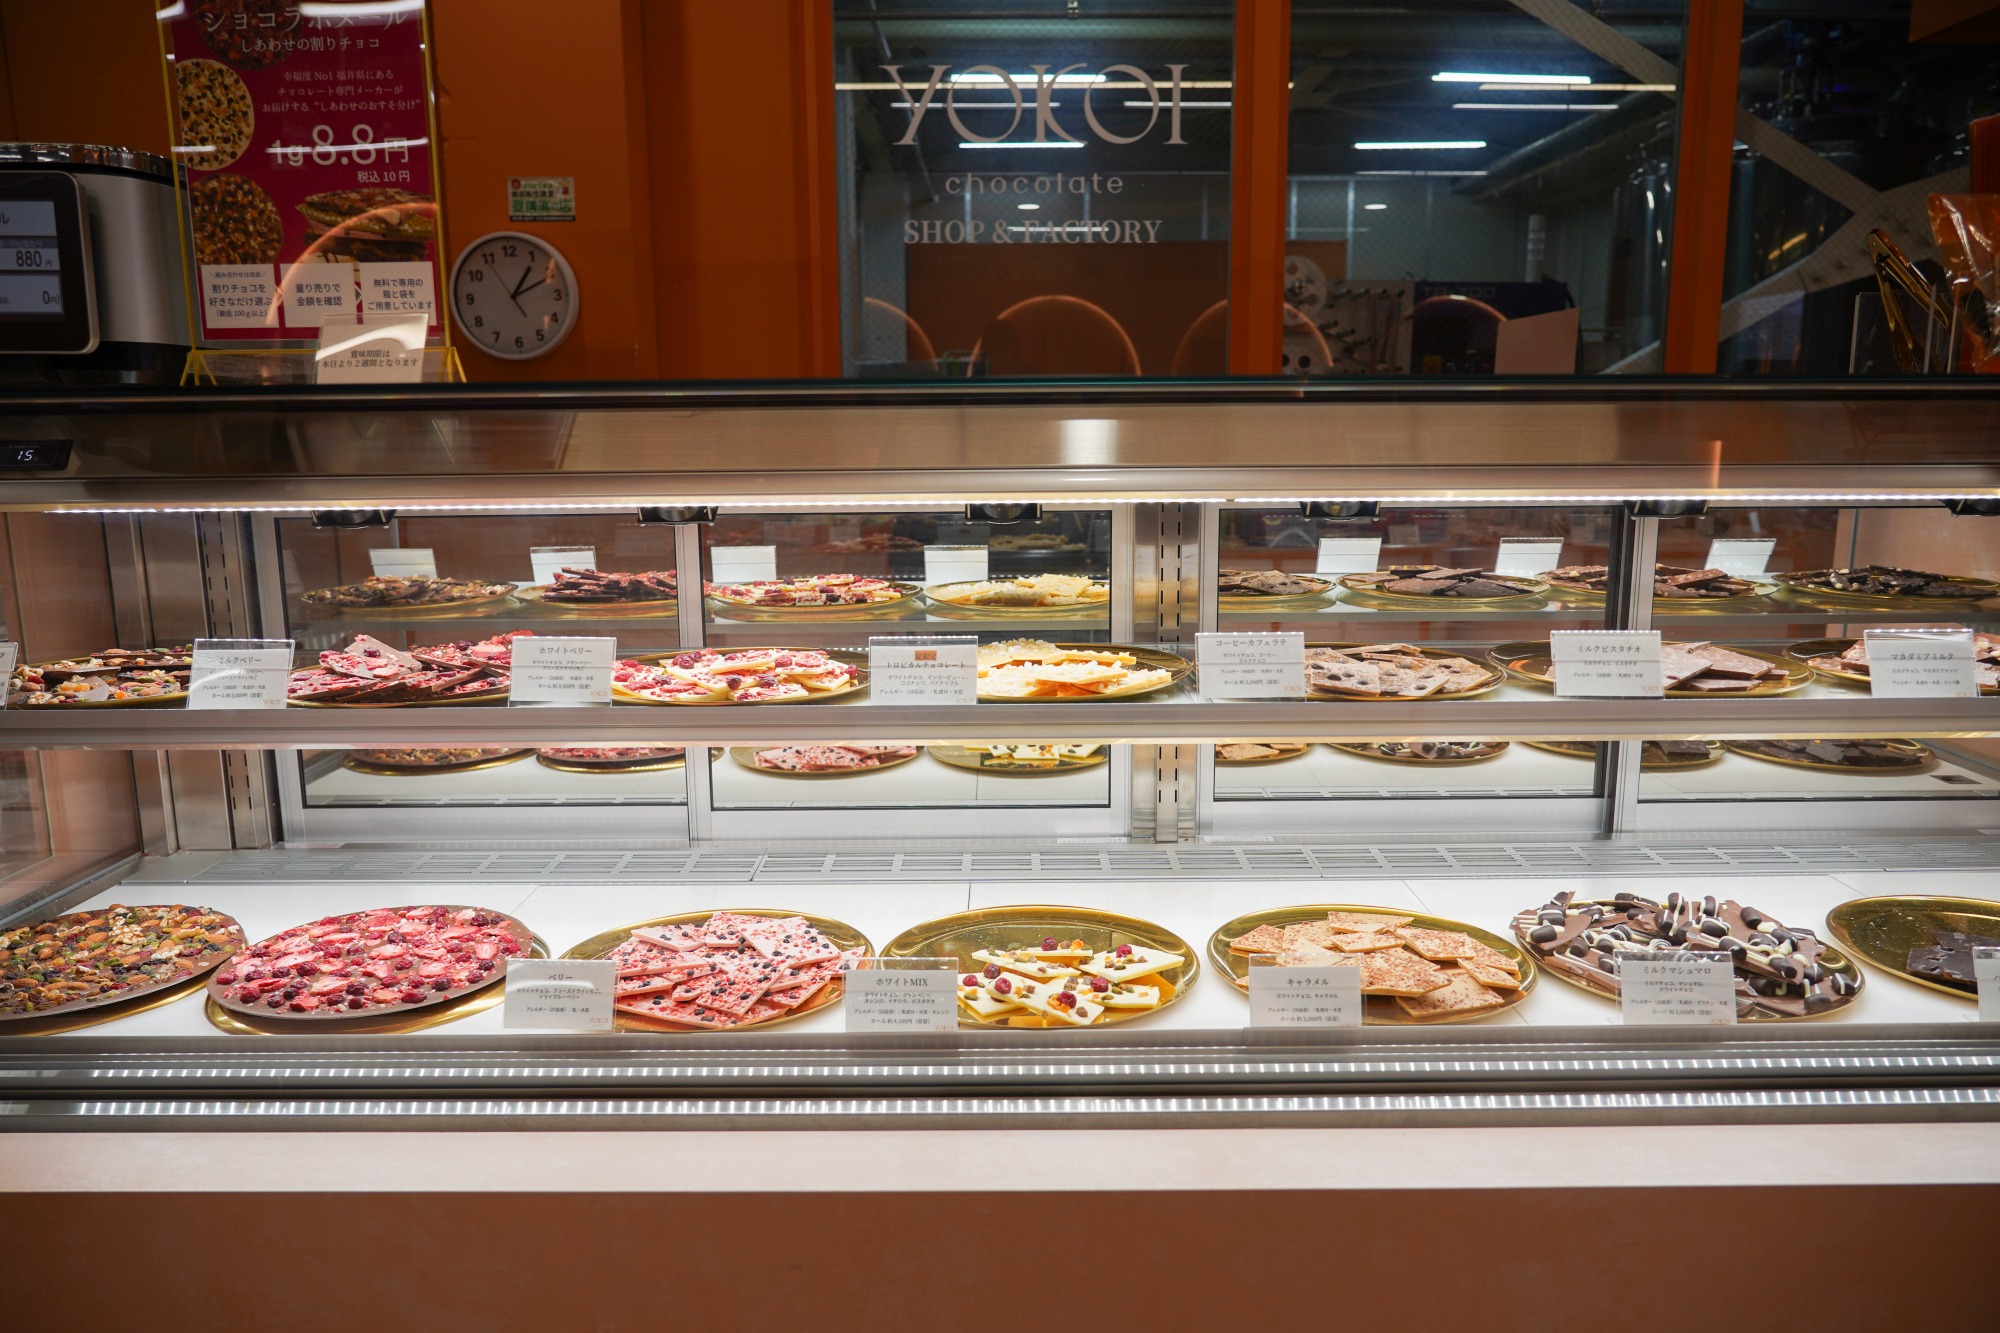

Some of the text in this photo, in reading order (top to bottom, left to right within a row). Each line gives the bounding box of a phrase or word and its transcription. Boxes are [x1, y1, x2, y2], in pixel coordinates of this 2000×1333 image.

[241, 36, 380, 53] しあわせの割りチョコ
[337, 69, 394, 80] 福井県にある
[277, 84, 403, 97] チョコレート専門メーカーが
[879, 62, 1189, 146] YOKOI
[357, 170, 380, 183] 税込
[945, 172, 1124, 194] chocolate
[903, 219, 1163, 244] SHOP & FACTORY
[502, 245, 517, 258] 12
[528, 250, 535, 262] 1
[481, 252, 495, 265] 11
[468, 270, 484, 282] 10
[211, 283, 267, 294] 割りチョコを
[295, 283, 341, 294] 量り売りで
[373, 278, 424, 288] 無料で専用の
[382, 289, 415, 299] 箱と袋を
[466, 293, 475, 305] 9
[553, 289, 562, 301] 3
[209, 296, 273, 307] 好きなだけ選ぶ
[296, 296, 343, 307] 金額を確認
[367, 300, 433, 311] ご用意しています
[474, 315, 483, 328] 8
[550, 312, 559, 324] 4
[492, 331, 500, 343] 7
[535, 329, 545, 342] 5
[514, 336, 523, 348] 6
[350, 349, 391, 359] 賞味期限は
[17, 449, 34, 461] 15
[1216, 639, 1287, 647] コーヒーカフェラテ
[539, 647, 593, 655] ホワイトベリー
[1577, 645, 1641, 653] ミルクピスタチオ
[219, 656, 262, 664] ミルクベリー
[1890, 652, 1954, 661] マカダミアミルク
[887, 661, 965, 669] トロピカルチョコレート
[1644, 966, 1711, 974] ミルクマシュマロ
[548, 973, 573, 981] ベリー
[876, 977, 929, 986] ホワイトMIX
[1287, 977, 1330, 986] キャラメル
